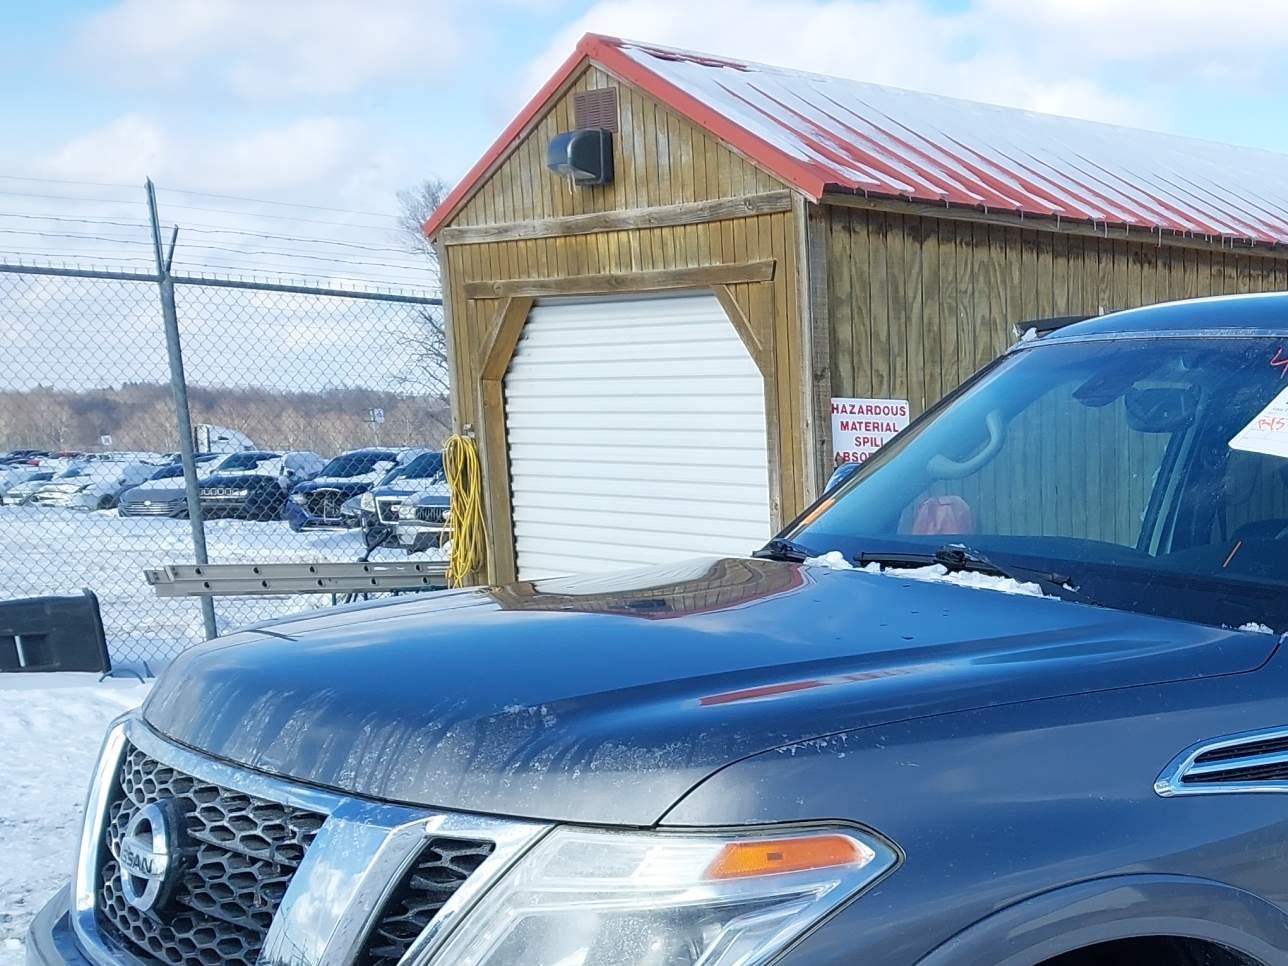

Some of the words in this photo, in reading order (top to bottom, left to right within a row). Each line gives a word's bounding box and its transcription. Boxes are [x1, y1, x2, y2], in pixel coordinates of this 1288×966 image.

[831, 404, 906, 416] HAZARDOUS
[840, 421, 899, 432] MATERIAL
[835, 451, 873, 463] ABSO
